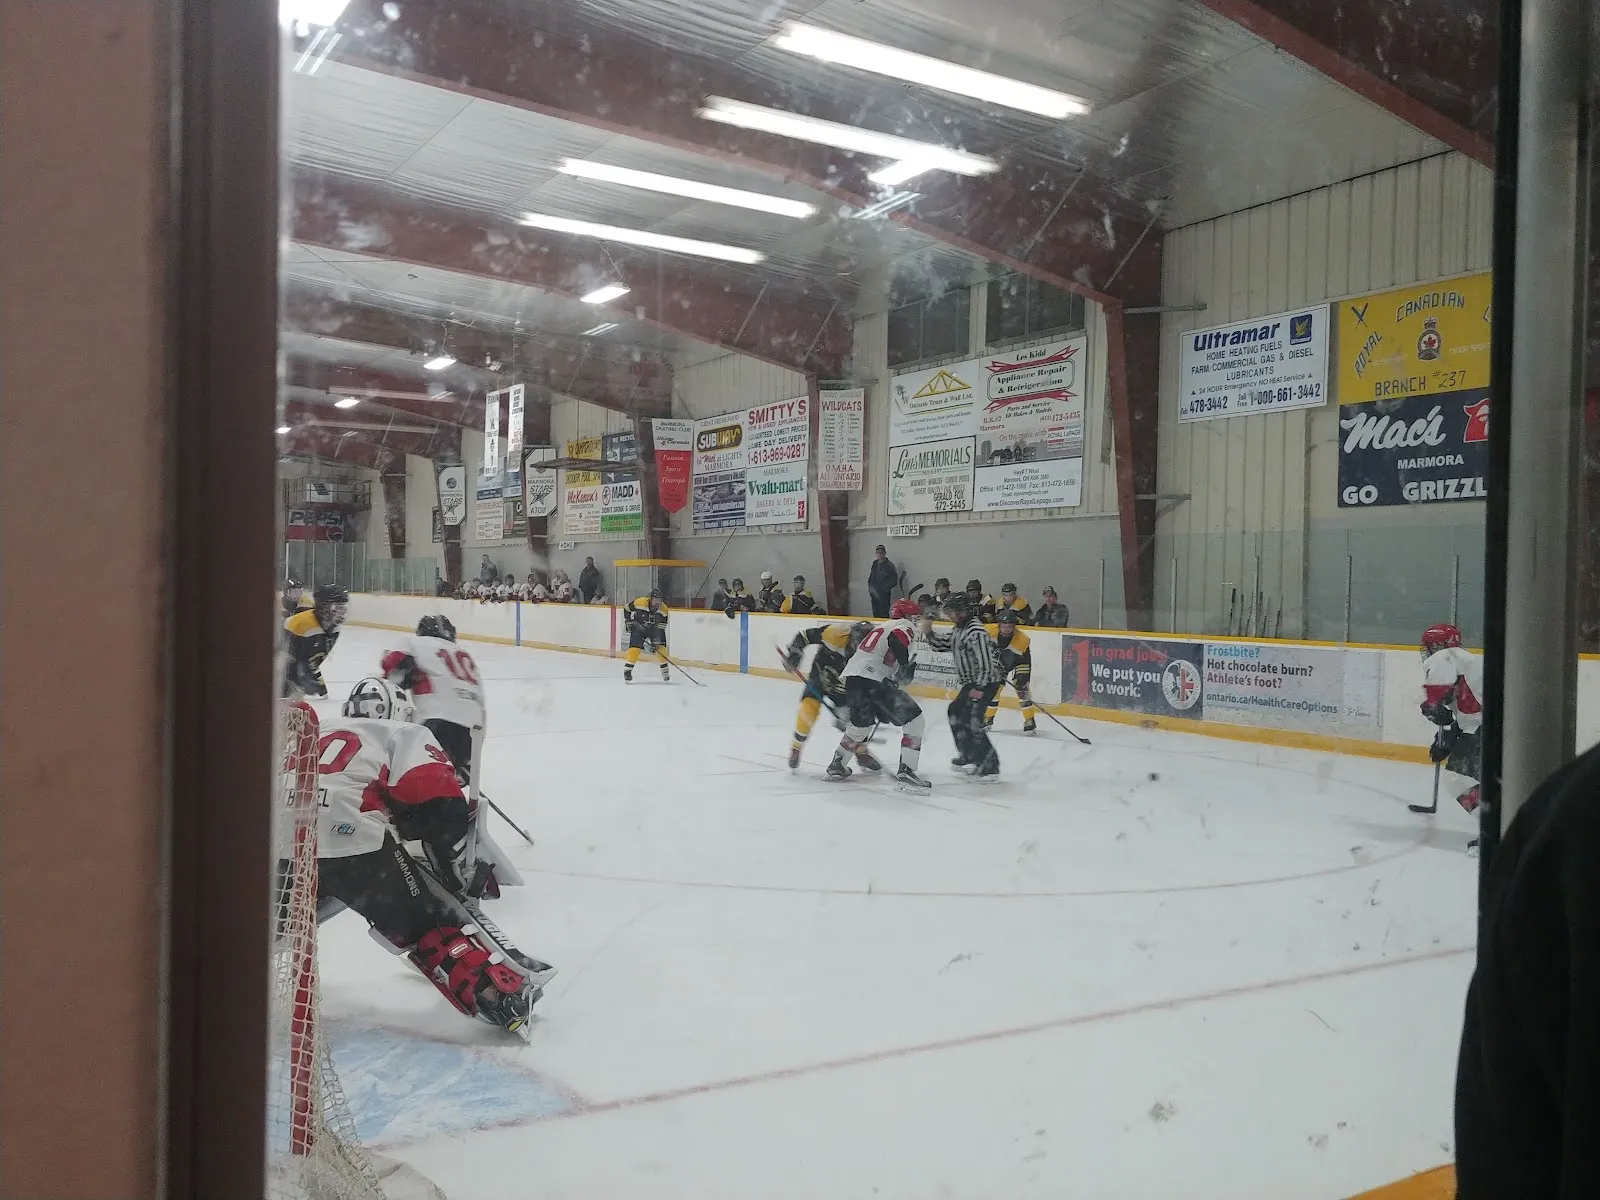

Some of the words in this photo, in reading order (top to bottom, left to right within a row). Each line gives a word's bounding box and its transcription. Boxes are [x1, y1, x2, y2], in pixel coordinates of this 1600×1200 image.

[1395, 292, 1465, 323] CANADIAN
[1194, 323, 1280, 352] Ultramar
[1029, 349, 1047, 358] Kidd
[1206, 350, 1226, 361] HOME
[1229, 345, 1258, 357] HEATING
[1260, 340, 1283, 353] FUELS
[1260, 354, 1276, 364] GAS
[1279, 353, 1285, 361] &
[1289, 348, 1314, 360] DIESEL
[1353, 330, 1384, 378] ROYAL
[996, 372, 1036, 384] Appliance
[1037, 366, 1067, 377] Repair
[1226, 366, 1275, 381] LUBRICANTS
[1207, 384, 1223, 393] HOUR
[1225, 380, 1257, 391] Emergency
[1269, 375, 1283, 384] HEAT
[1284, 373, 1306, 382] Service
[1375, 376, 1427, 396] BRANCH
[748, 399, 806, 425] SMITTY'S
[821, 400, 862, 412] WILDCATS
[1189, 396, 1228, 413] 478-3442
[778, 416, 807, 426] APPLIANCES
[791, 424, 807, 433] PRICES
[1340, 405, 1447, 454] Mac's
[698, 427, 740, 449] SUBWAY
[779, 434, 807, 444] DELIVERY
[999, 434, 1007, 442] On
[1007, 432, 1017, 440] the
[748, 443, 806, 465] 1-613-969-0287
[919, 446, 971, 469] MEMORIALS
[1397, 454, 1464, 470] MARMORA
[764, 467, 788, 476] MARMORA
[833, 473, 860, 481] ONTARIO
[612, 485, 633, 499] MADD
[1342, 484, 1379, 505] GO
[1402, 476, 1488, 501] GRIZZL
[935, 500, 966, 511] 472-5445
[289, 511, 343, 525] PSI
[889, 525, 918, 535] VISITORS
[1092, 645, 1103, 657] in
[1106, 647, 1133, 660] grad
[1207, 645, 1260, 658] Frostbite?
[1092, 664, 1110, 678] We
[1113, 668, 1135, 682] put
[1136, 671, 1160, 685] you
[1207, 659, 1225, 670] Hot
[1228, 660, 1278, 674] chocolate
[1281, 663, 1314, 677] burn?
[1091, 681, 1105, 693] to
[1207, 672, 1251, 686] Athlete's
[1254, 676, 1283, 689] foot?
[1206, 693, 1338, 714] ontario.ca/HealthCareOptions
[394, 849, 421, 897] SIMMONS
